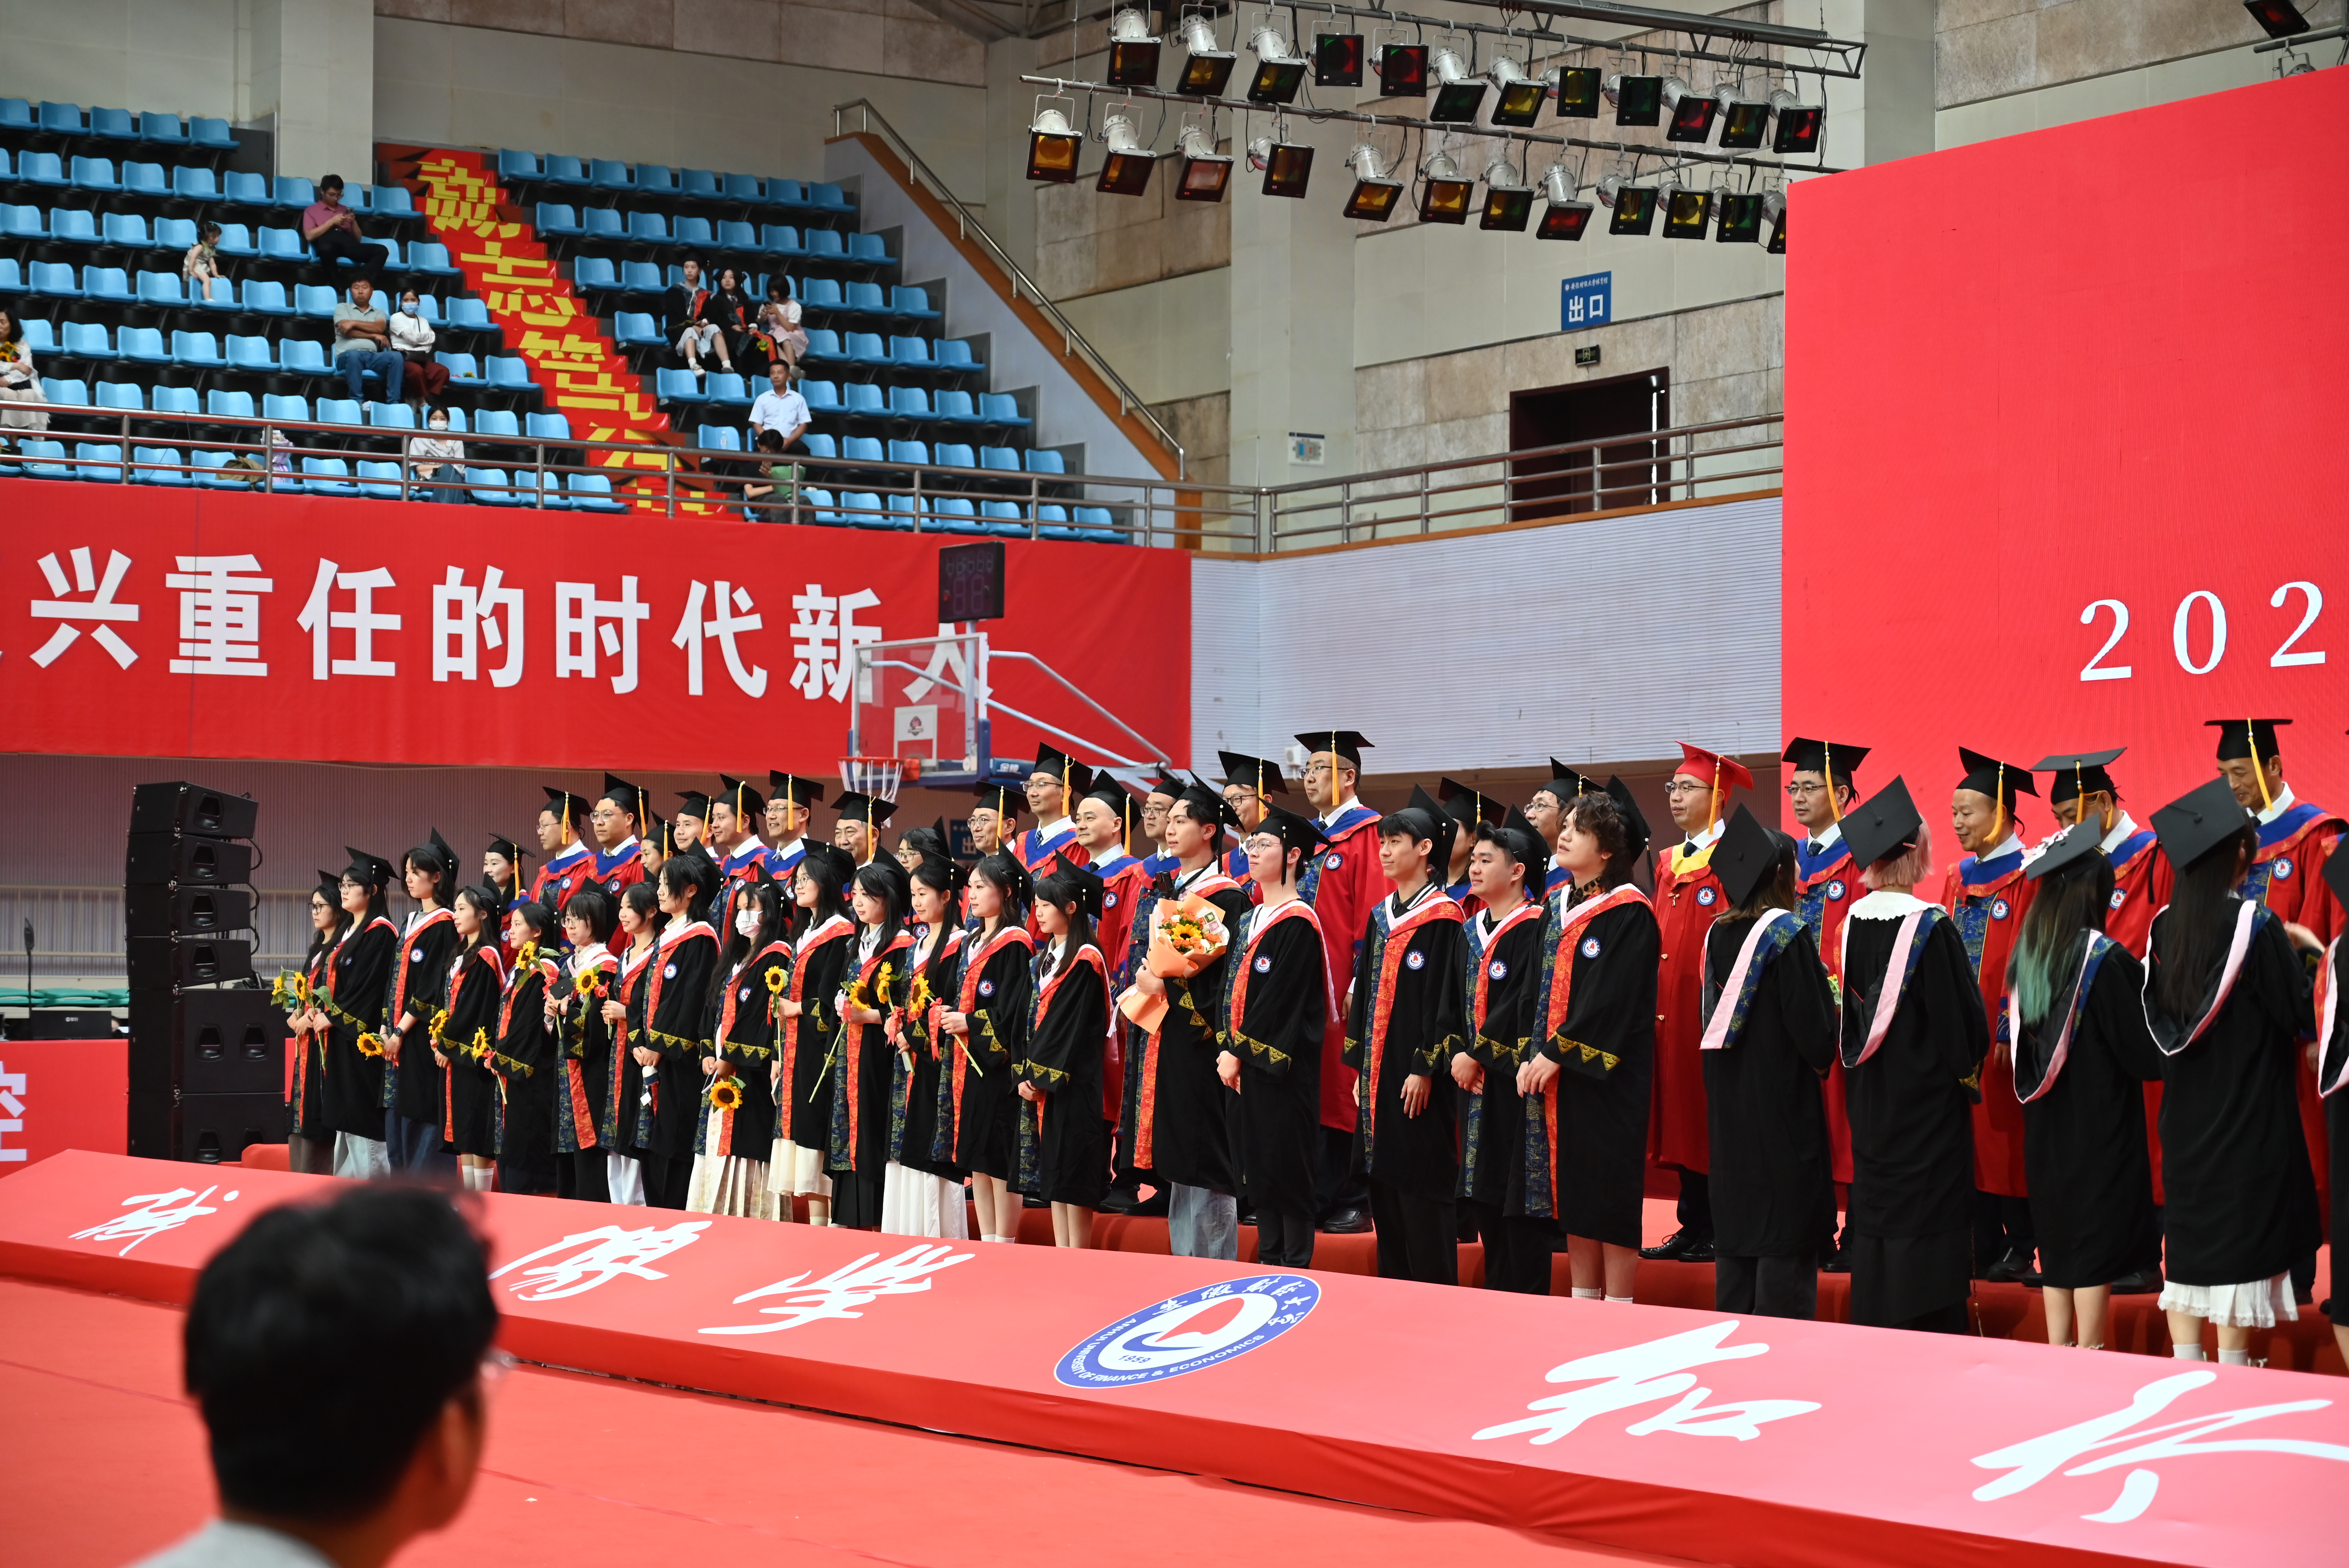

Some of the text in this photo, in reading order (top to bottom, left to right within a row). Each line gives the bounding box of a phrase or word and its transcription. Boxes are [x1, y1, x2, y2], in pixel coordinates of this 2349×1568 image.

[1568, 294, 1603, 323] 出口
[0, 546, 994, 703] 兴重任的时代新人
[1095, 1318, 1137, 1341] ANHUI
[1071, 1342, 1100, 1374] UNIVERSITY
[1118, 1354, 1151, 1363] 1959
[1169, 1335, 1265, 1373] ECONOMICS
[1089, 1372, 1149, 1382] FINANCE
